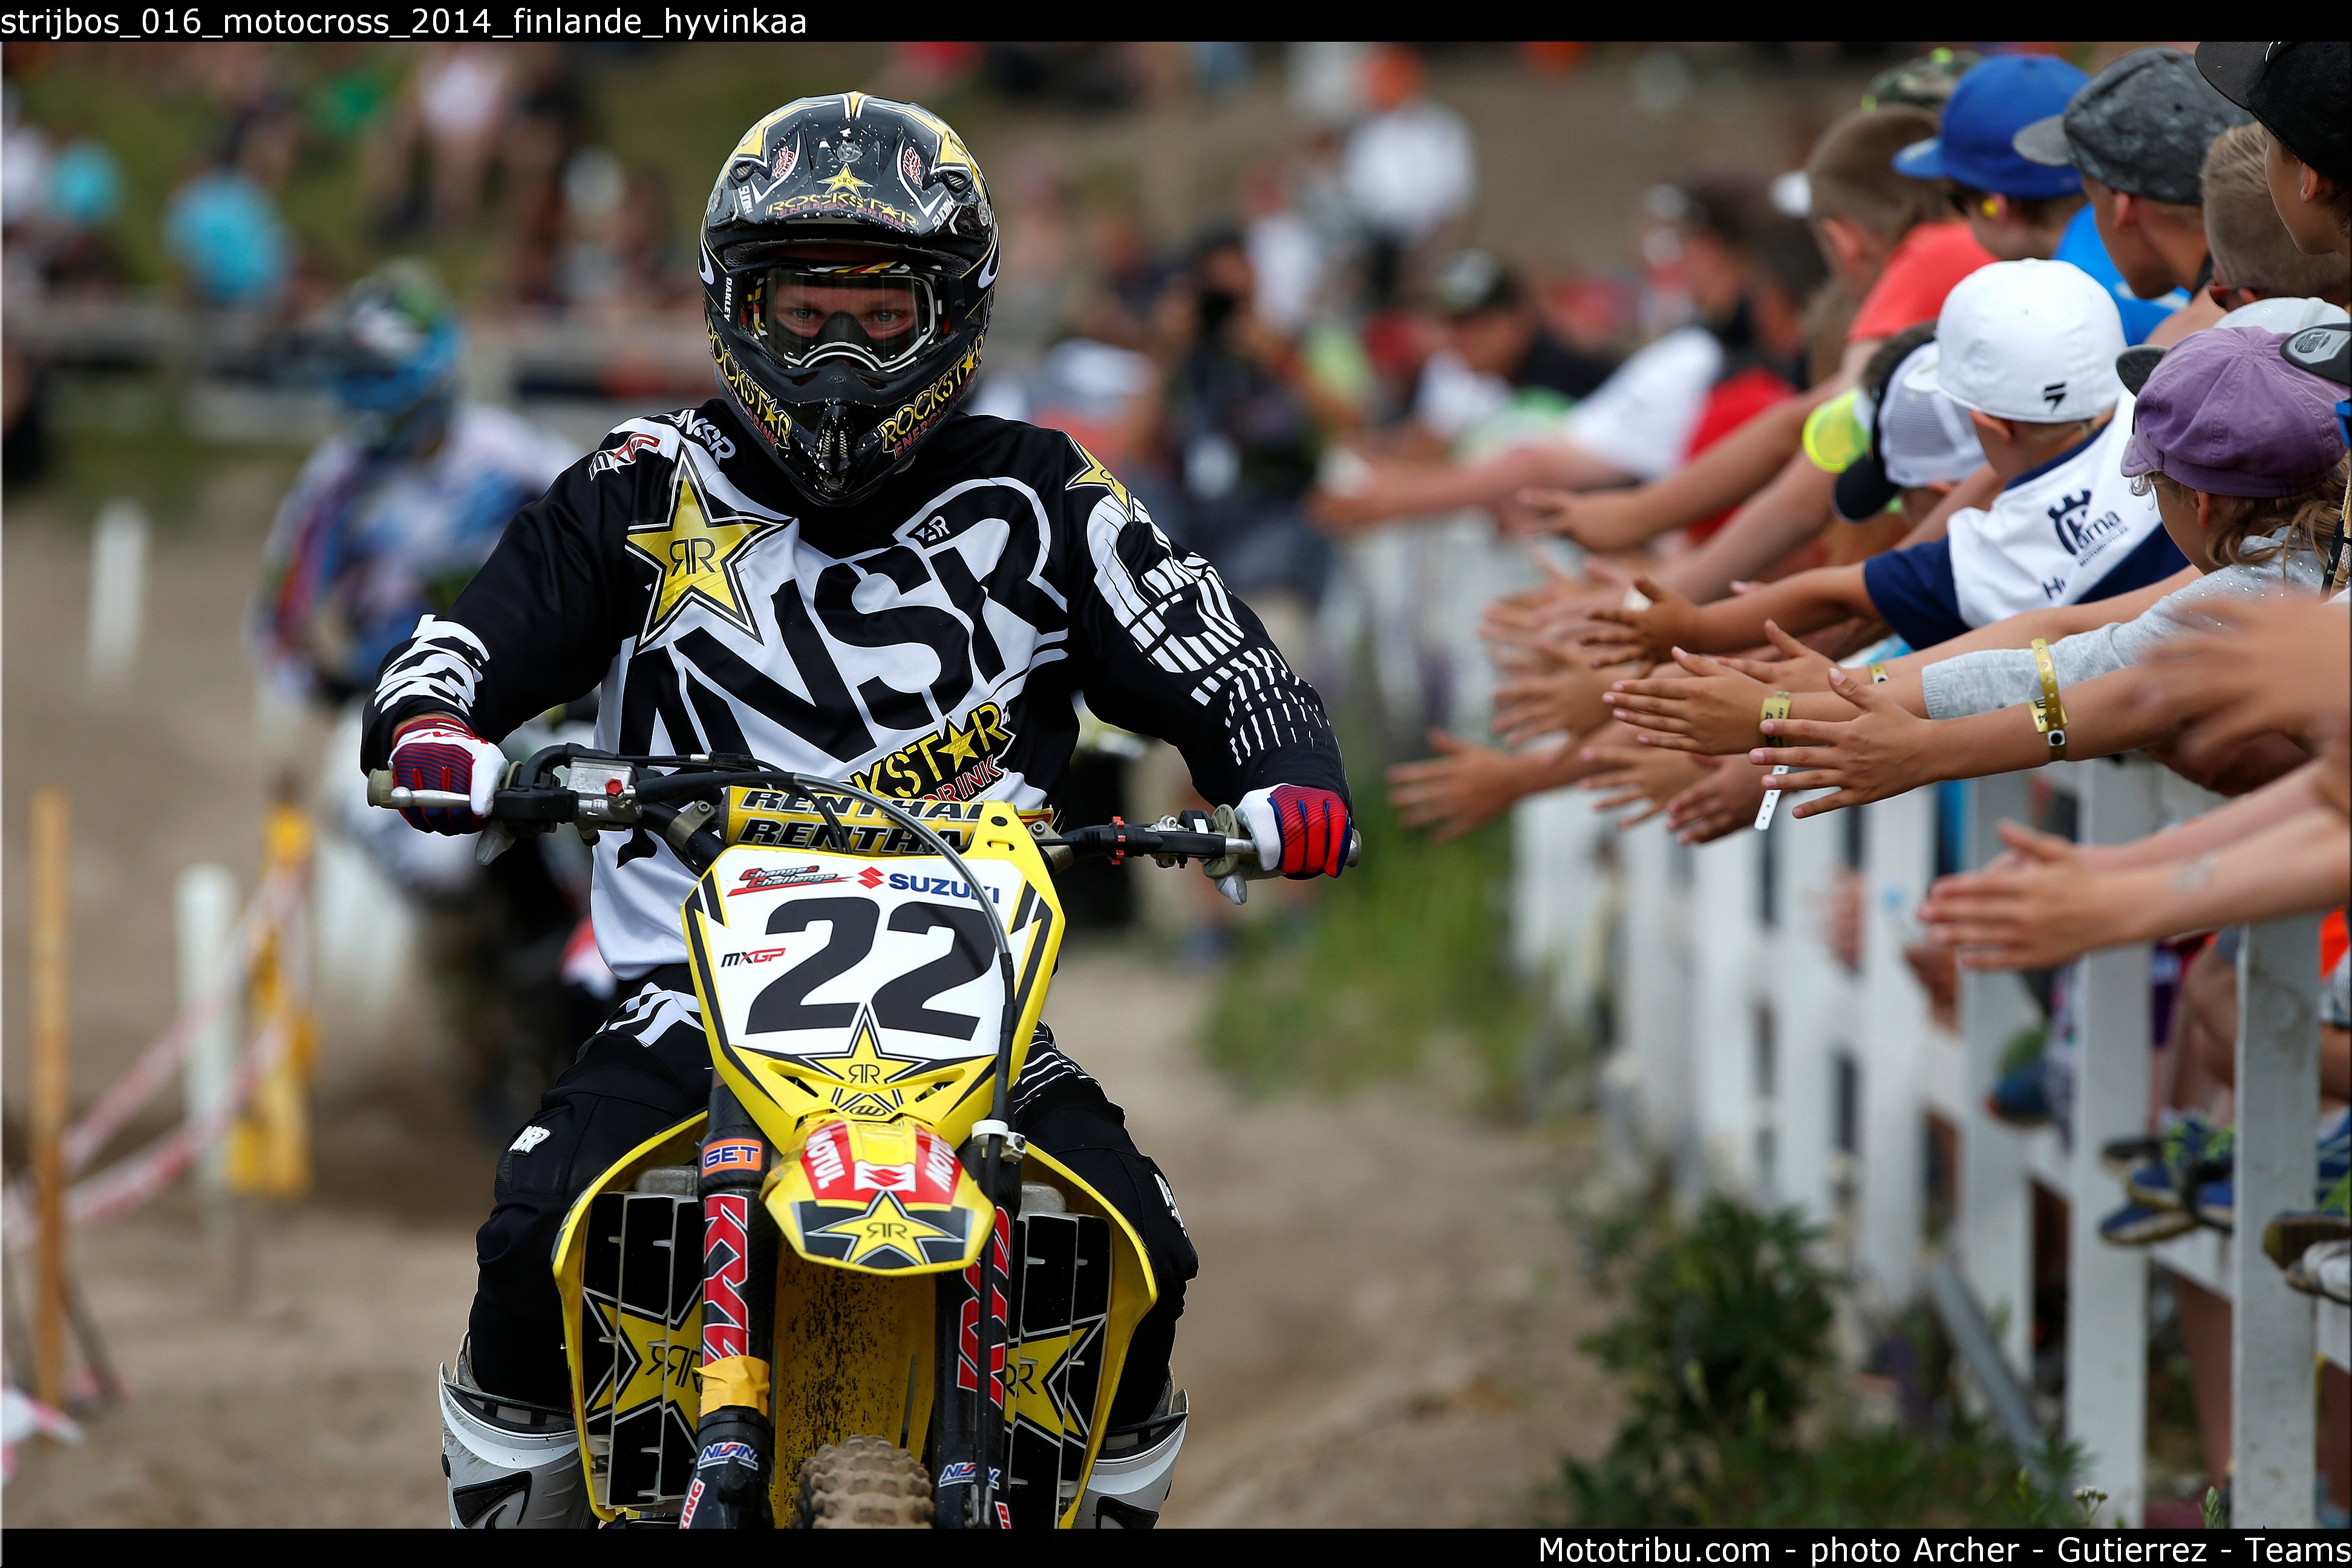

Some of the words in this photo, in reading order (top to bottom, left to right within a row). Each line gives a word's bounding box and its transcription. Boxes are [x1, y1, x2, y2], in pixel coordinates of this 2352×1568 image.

[931, 195, 956, 233] SUOMY
[724, 276, 733, 322] OAKLEY
[921, 754, 1002, 801] RINK
[746, 874, 838, 889] Challenge
[720, 947, 786, 968] MXGP
[745, 896, 997, 1041] 22
[704, 1145, 760, 1169] GET
[805, 1129, 846, 1190] MOTUL
